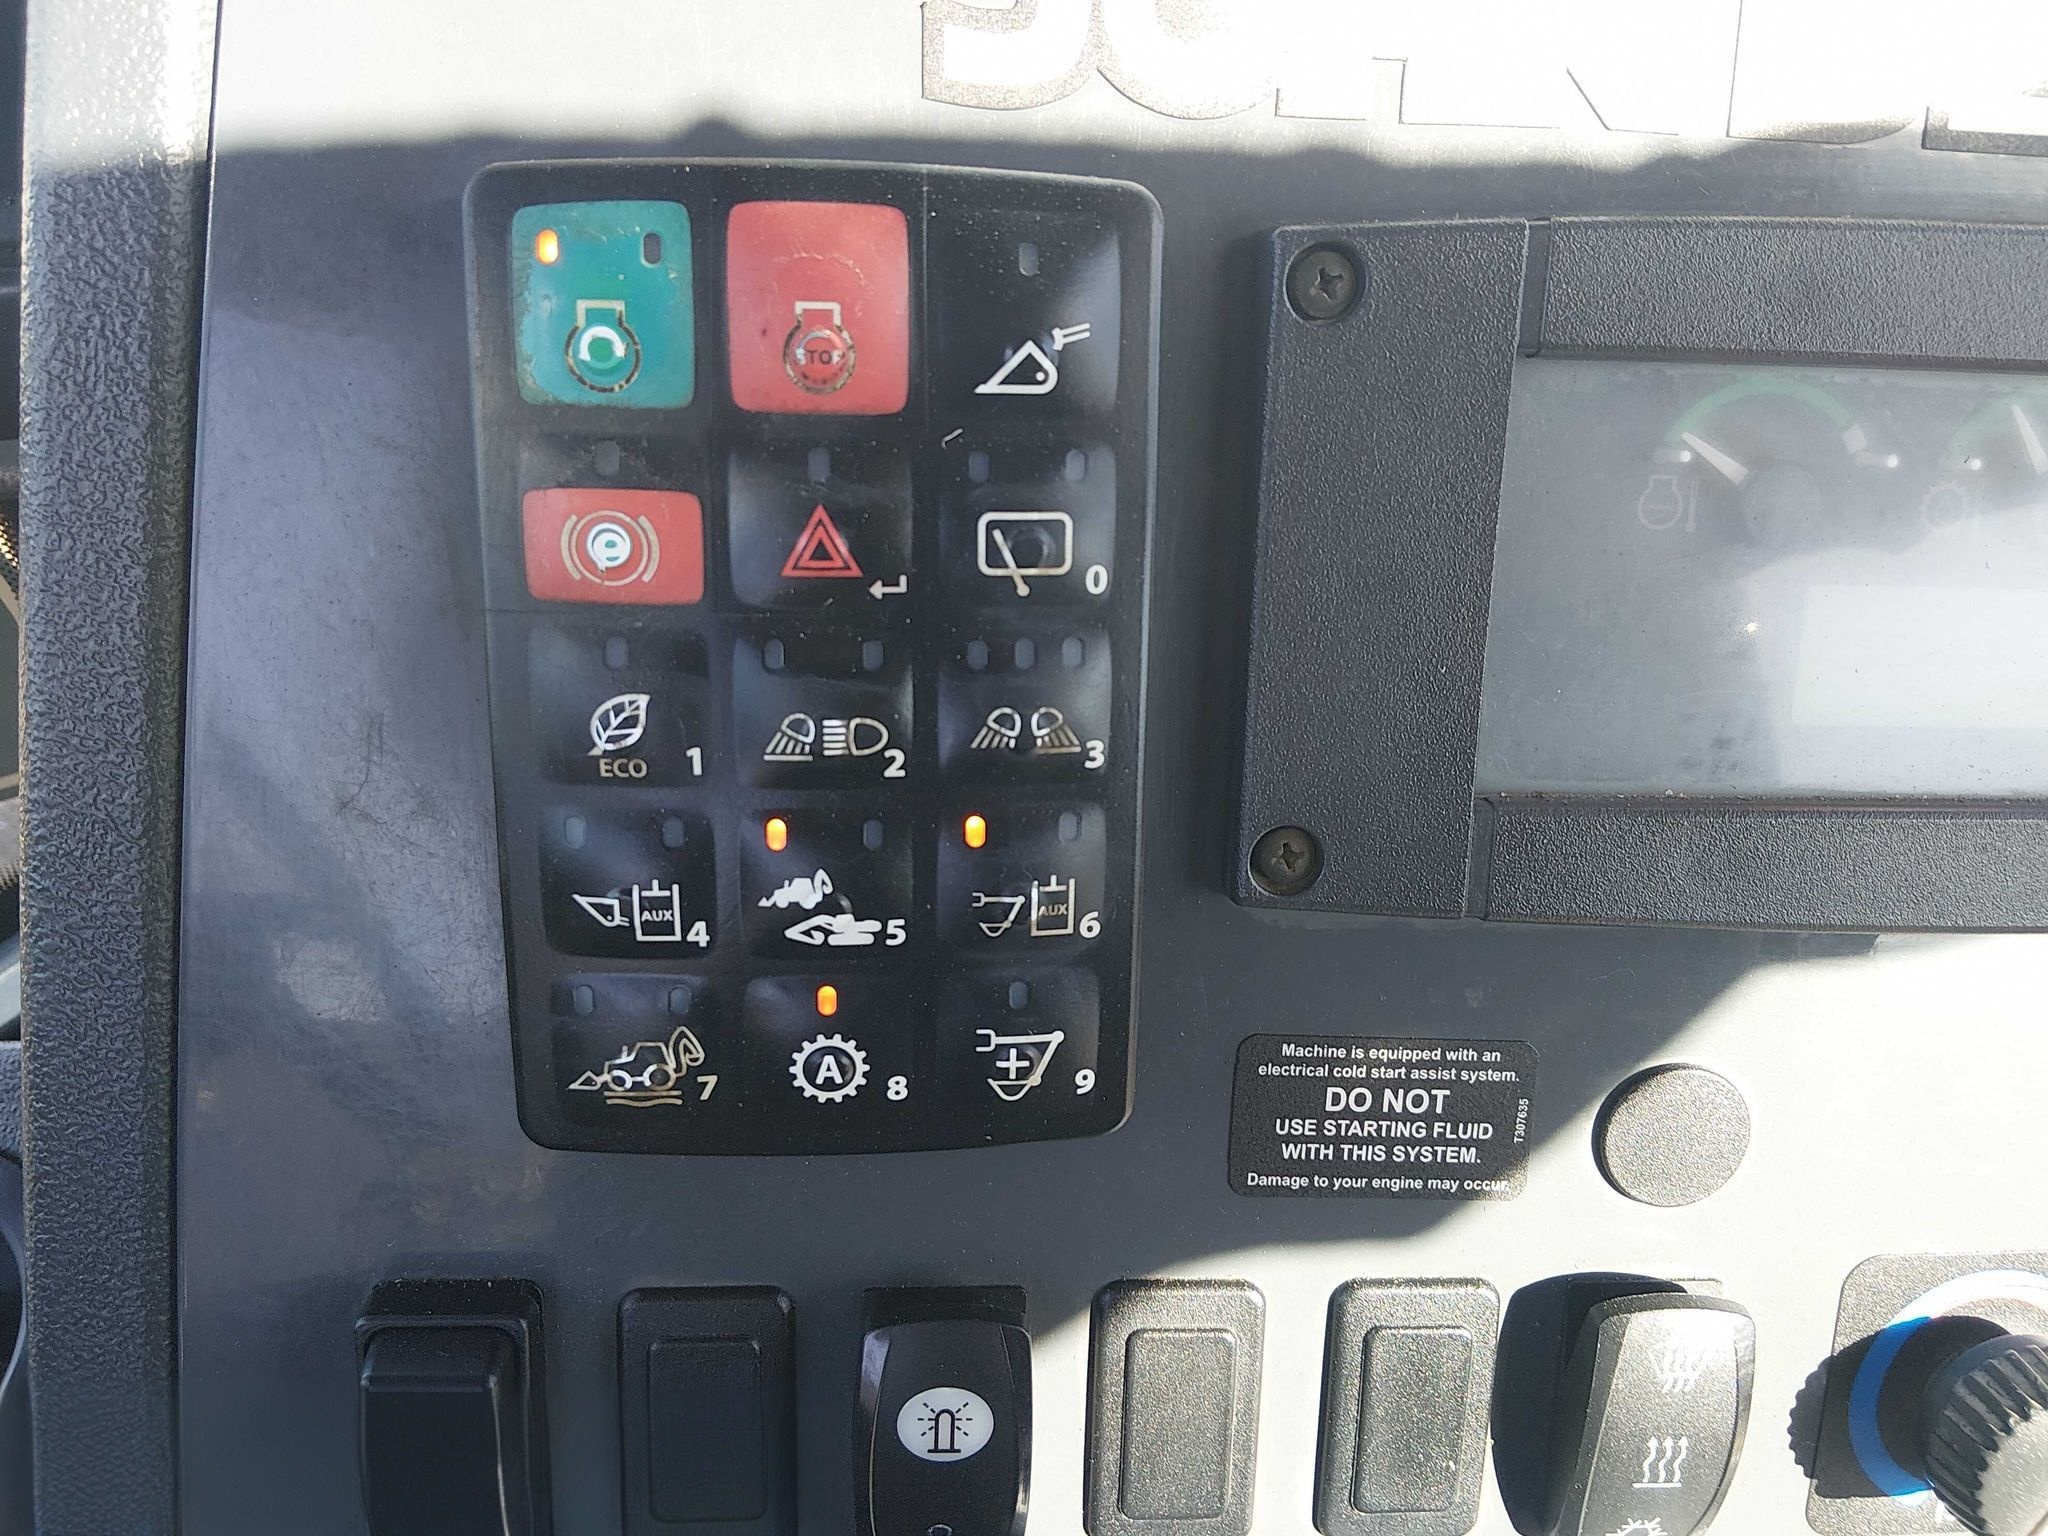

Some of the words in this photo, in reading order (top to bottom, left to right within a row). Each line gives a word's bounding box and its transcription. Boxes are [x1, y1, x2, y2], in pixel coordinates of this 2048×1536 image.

[796, 349, 846, 365] TO
[1086, 564, 1108, 595] 0
[686, 747, 703, 776] 1
[884, 749, 907, 778] 2
[1084, 741, 1106, 768] 3
[599, 758, 648, 779] ECO
[641, 909, 673, 923] AUX
[1038, 903, 1069, 917] AUX
[686, 921, 711, 948] 4
[885, 919, 907, 947] 5
[1079, 913, 1101, 939] 6
[1281, 1043, 1347, 1058] Machine
[1351, 1045, 1365, 1059] is
[1368, 1047, 1441, 1063] equipped
[1445, 1048, 1478, 1061] with
[1482, 1051, 1501, 1062] an
[815, 1055, 843, 1084] A
[1258, 1062, 1329, 1077] electrical
[1333, 1064, 1367, 1078] cold
[1370, 1066, 1406, 1079] start
[1410, 1067, 1457, 1080] assist
[1460, 1068, 1520, 1083] system.
[696, 1076, 719, 1101] 7
[886, 1076, 909, 1101] 8
[1074, 1070, 1096, 1095] 9
[1325, 1086, 1373, 1113] DO
[1382, 1087, 1451, 1114] NOT
[1275, 1118, 1318, 1136] USE
[1323, 1119, 1428, 1139] STARTING
[1432, 1122, 1494, 1140] FLUID
[1513, 1098, 1529, 1144] T307635
[1281, 1142, 1335, 1160] WITH
[1339, 1144, 1387, 1162] THIS
[1391, 1145, 1482, 1164] SYSTEM.
[1246, 1172, 1310, 1189] Damage
[1313, 1174, 1329, 1187] to
[1332, 1177, 1369, 1190] your
[1371, 1176, 1424, 1192] engine
[1427, 1179, 1460, 1193] may
[1463, 1179, 1511, 1191] occur.
